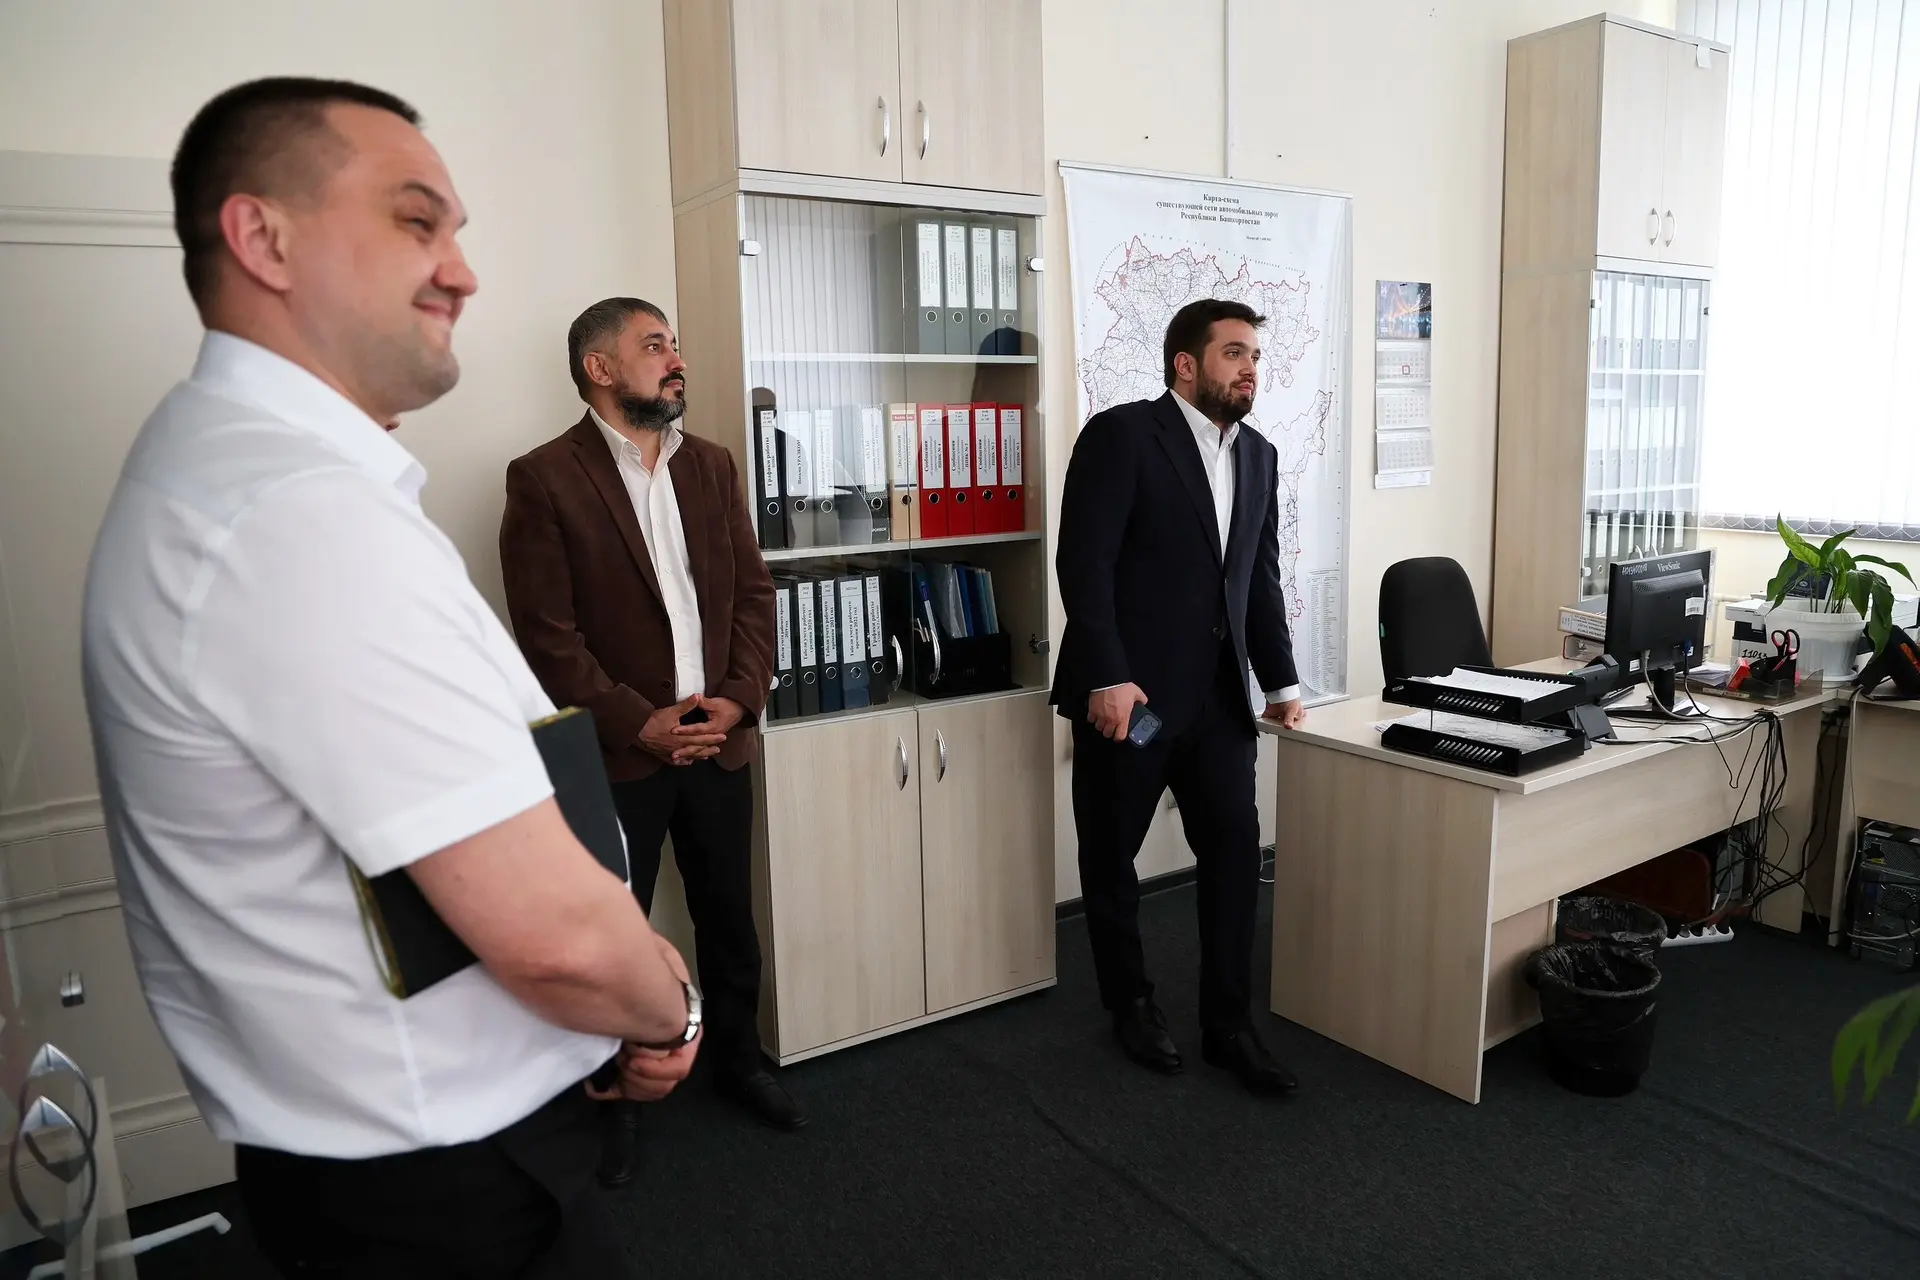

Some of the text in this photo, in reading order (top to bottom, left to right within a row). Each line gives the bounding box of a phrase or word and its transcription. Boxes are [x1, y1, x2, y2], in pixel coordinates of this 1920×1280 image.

[1203, 194, 1239, 204] Карта-схема
[1156, 201, 1203, 211] существующей
[1219, 207, 1263, 216] автомобильных
[1181, 212, 1260, 225] Республики Башкортостан
[766, 460, 774, 486] Графики
